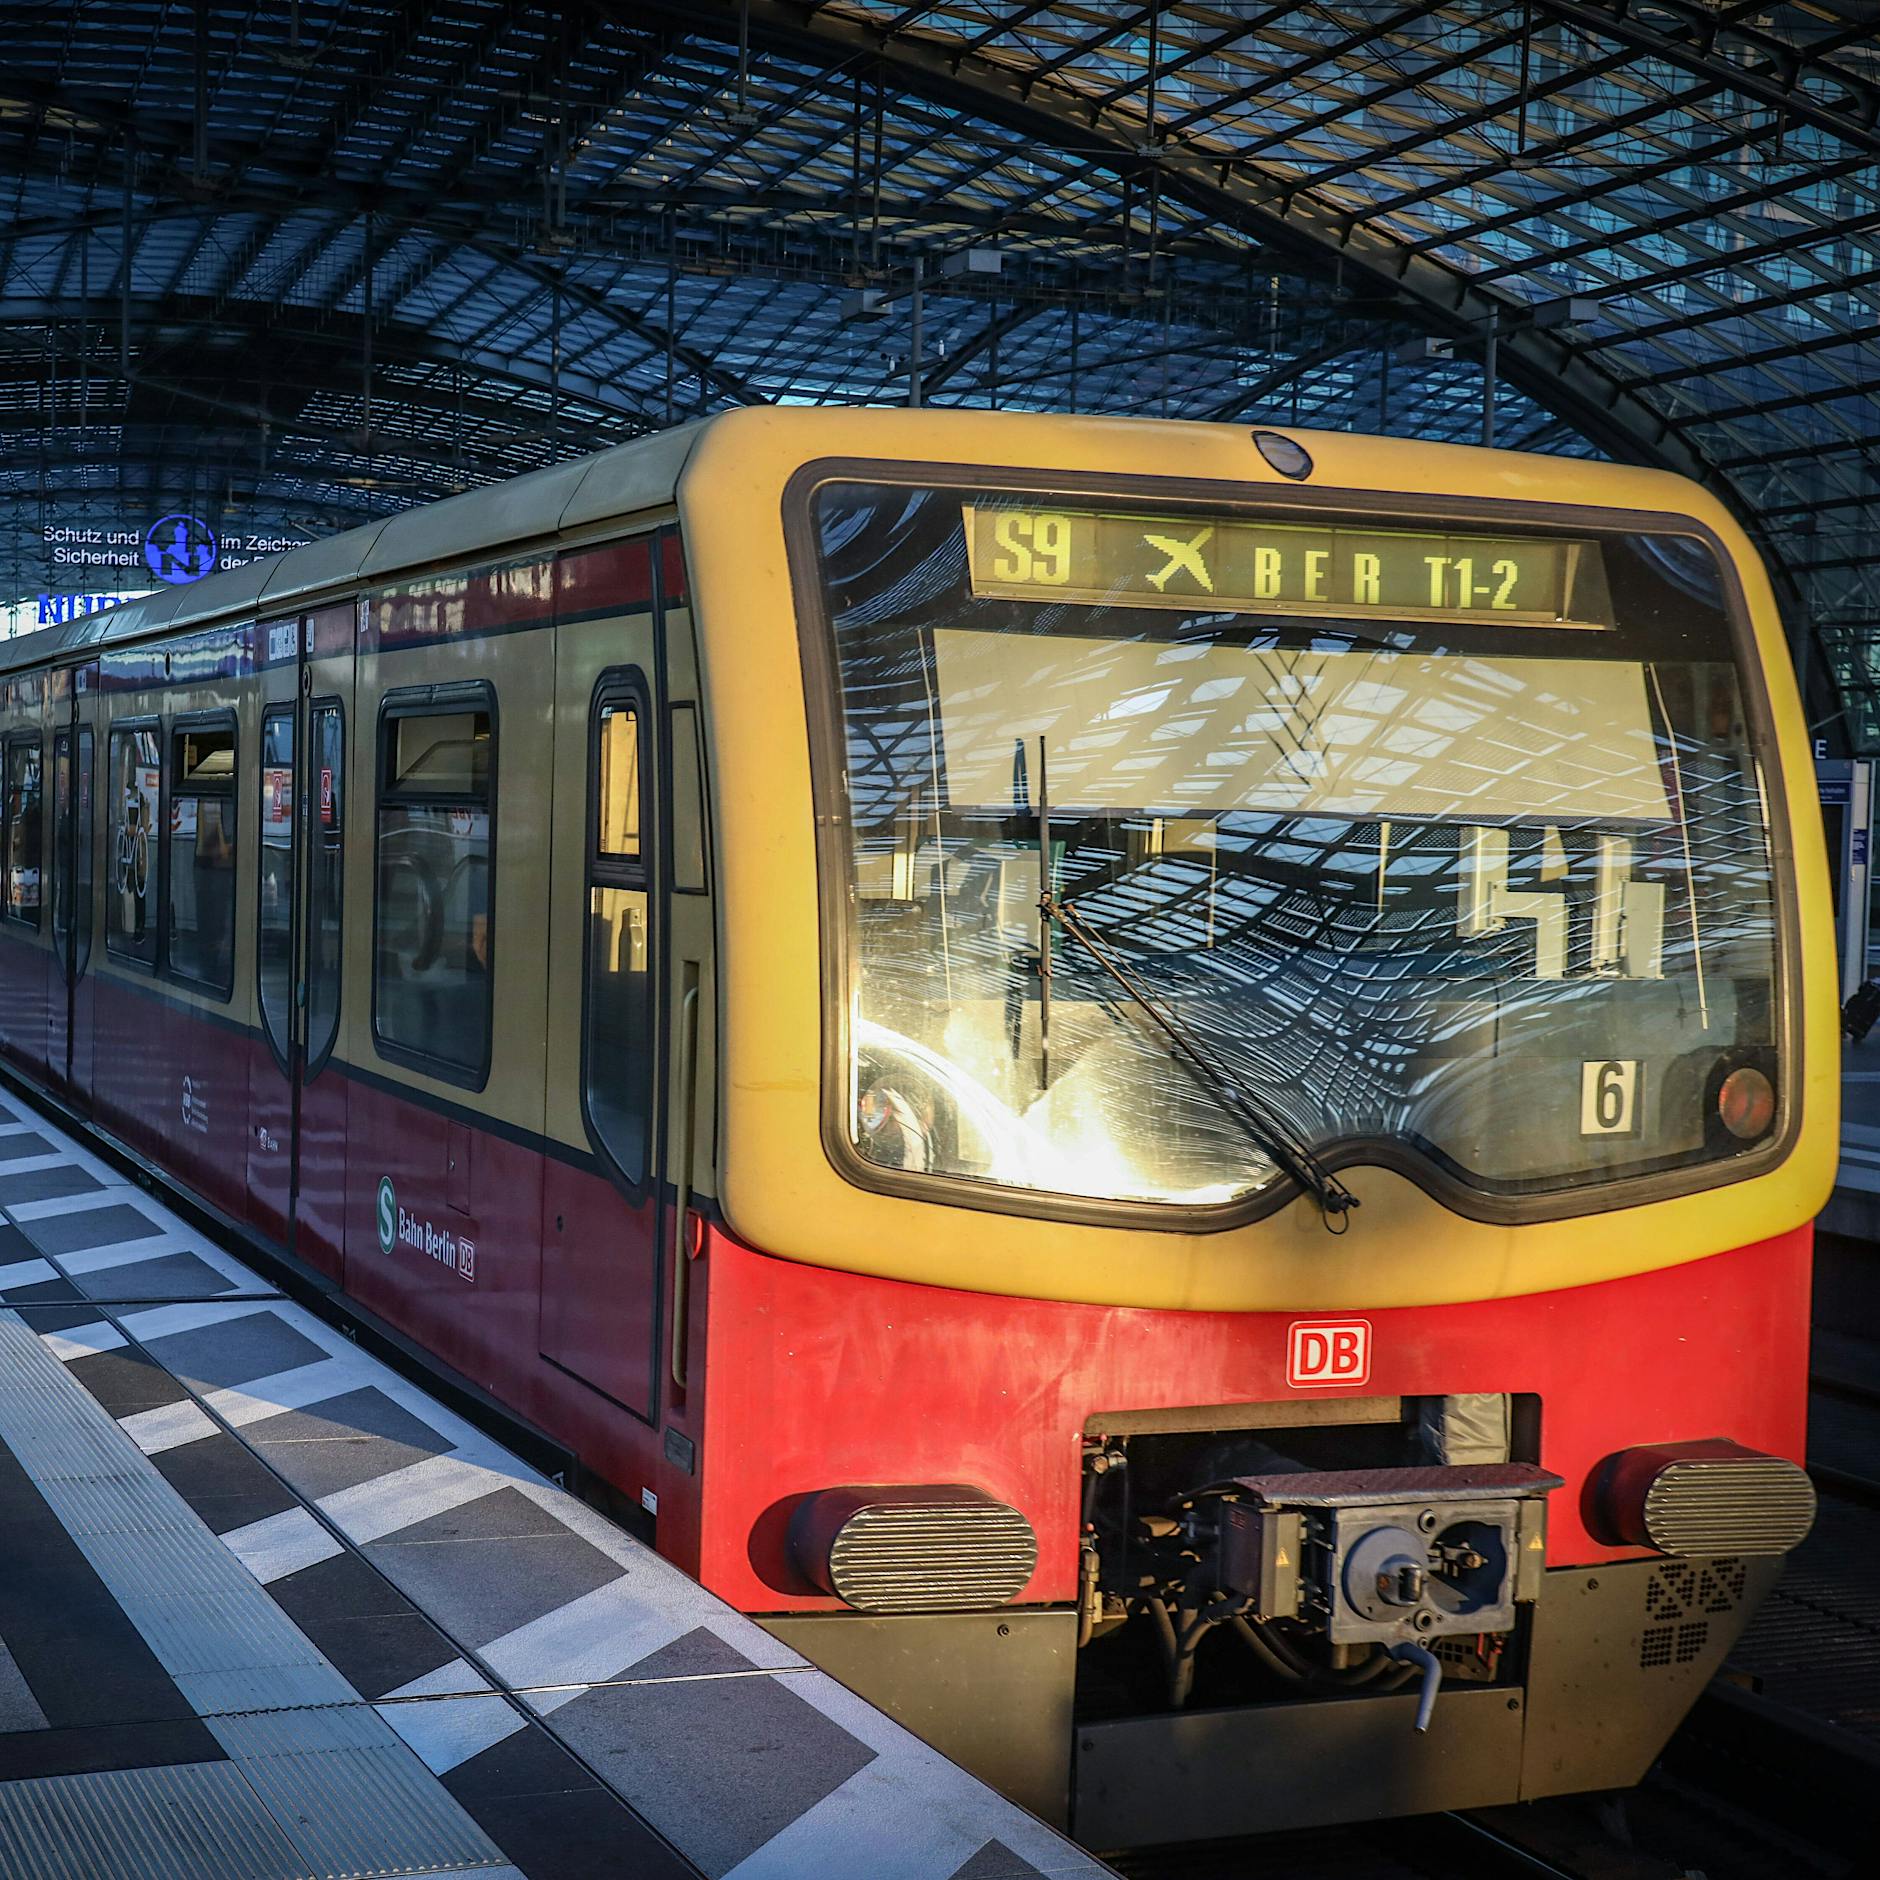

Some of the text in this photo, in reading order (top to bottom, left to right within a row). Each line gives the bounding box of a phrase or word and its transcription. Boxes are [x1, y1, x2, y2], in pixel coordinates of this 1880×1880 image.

[43, 525, 140, 545] Schutz und
[220, 534, 311, 551] im Zeiche
[54, 547, 140, 567] Sicherheit
[994, 511, 1071, 585] S9
[1424, 557, 1518, 610] T1-2
[1814, 739, 1828, 759] E
[1596, 1062, 1624, 1129] 6
[379, 1182, 394, 1248] S
[398, 1206, 456, 1269] Bahn Berlin
[460, 1240, 474, 1277] DB
[1297, 1329, 1361, 1377] DB
